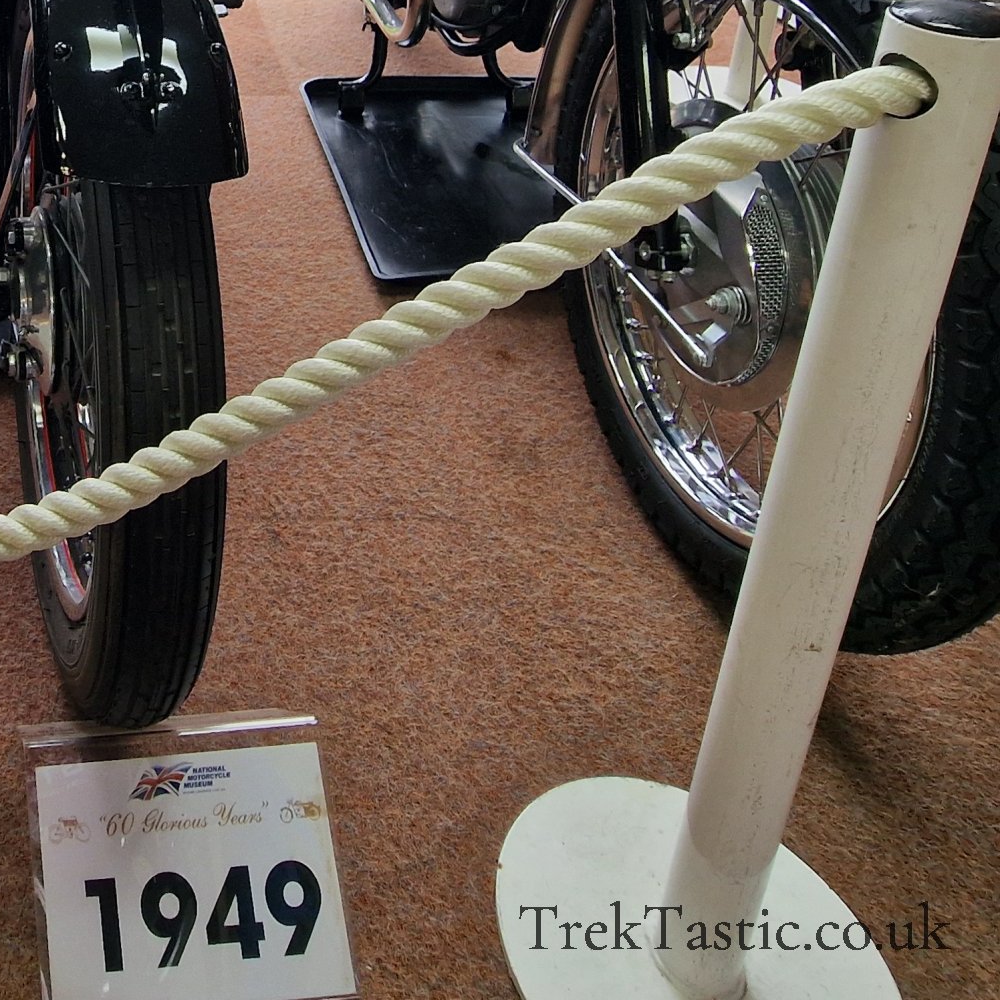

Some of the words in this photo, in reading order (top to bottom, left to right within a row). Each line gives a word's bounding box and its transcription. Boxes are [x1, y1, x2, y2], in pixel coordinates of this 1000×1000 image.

[192, 765, 227, 774] NATIONAL
[187, 772, 231, 781] MOTORCYCLE
[183, 780, 213, 789] MUSEUM
[142, 808, 208, 834] Glorious
[84, 859, 322, 973] 1949
